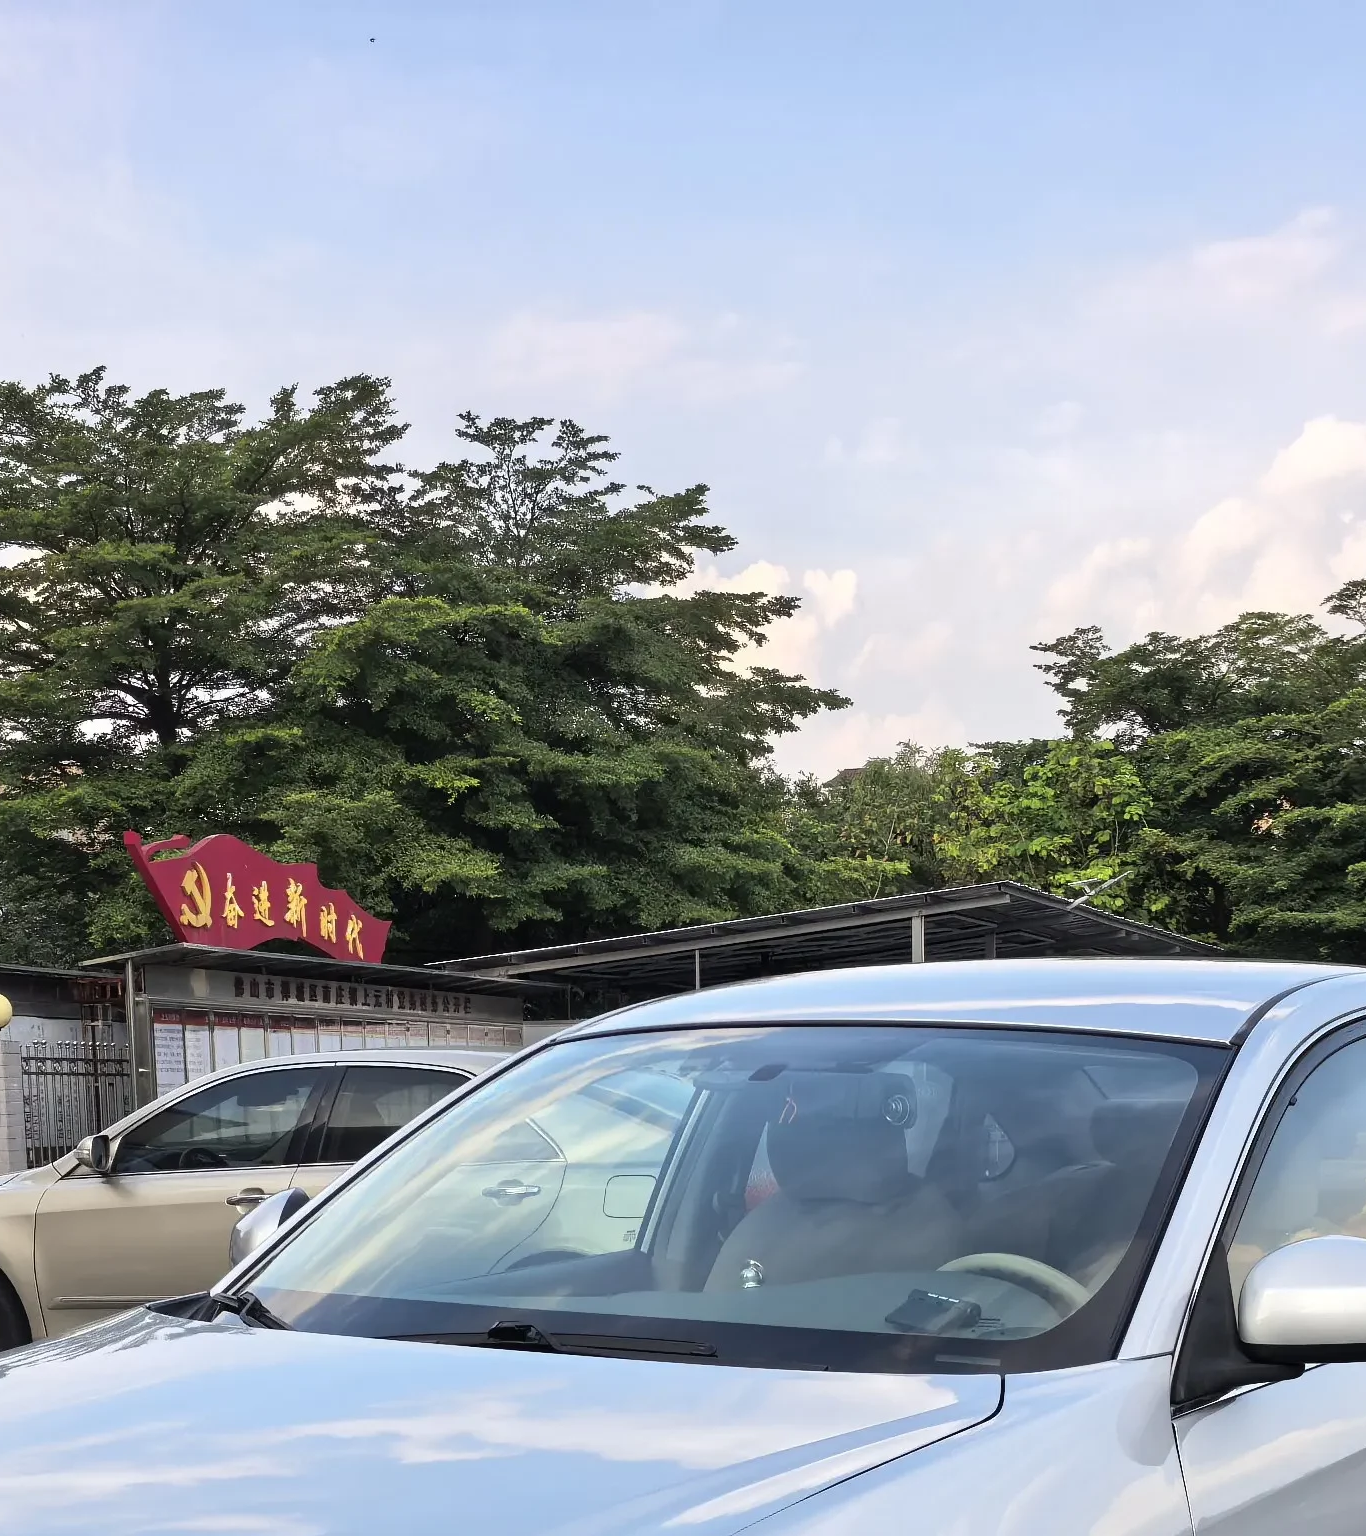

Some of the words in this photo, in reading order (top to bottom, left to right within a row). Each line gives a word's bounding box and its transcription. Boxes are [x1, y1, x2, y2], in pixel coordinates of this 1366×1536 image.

[222, 872, 363, 960] 奋进新时代
